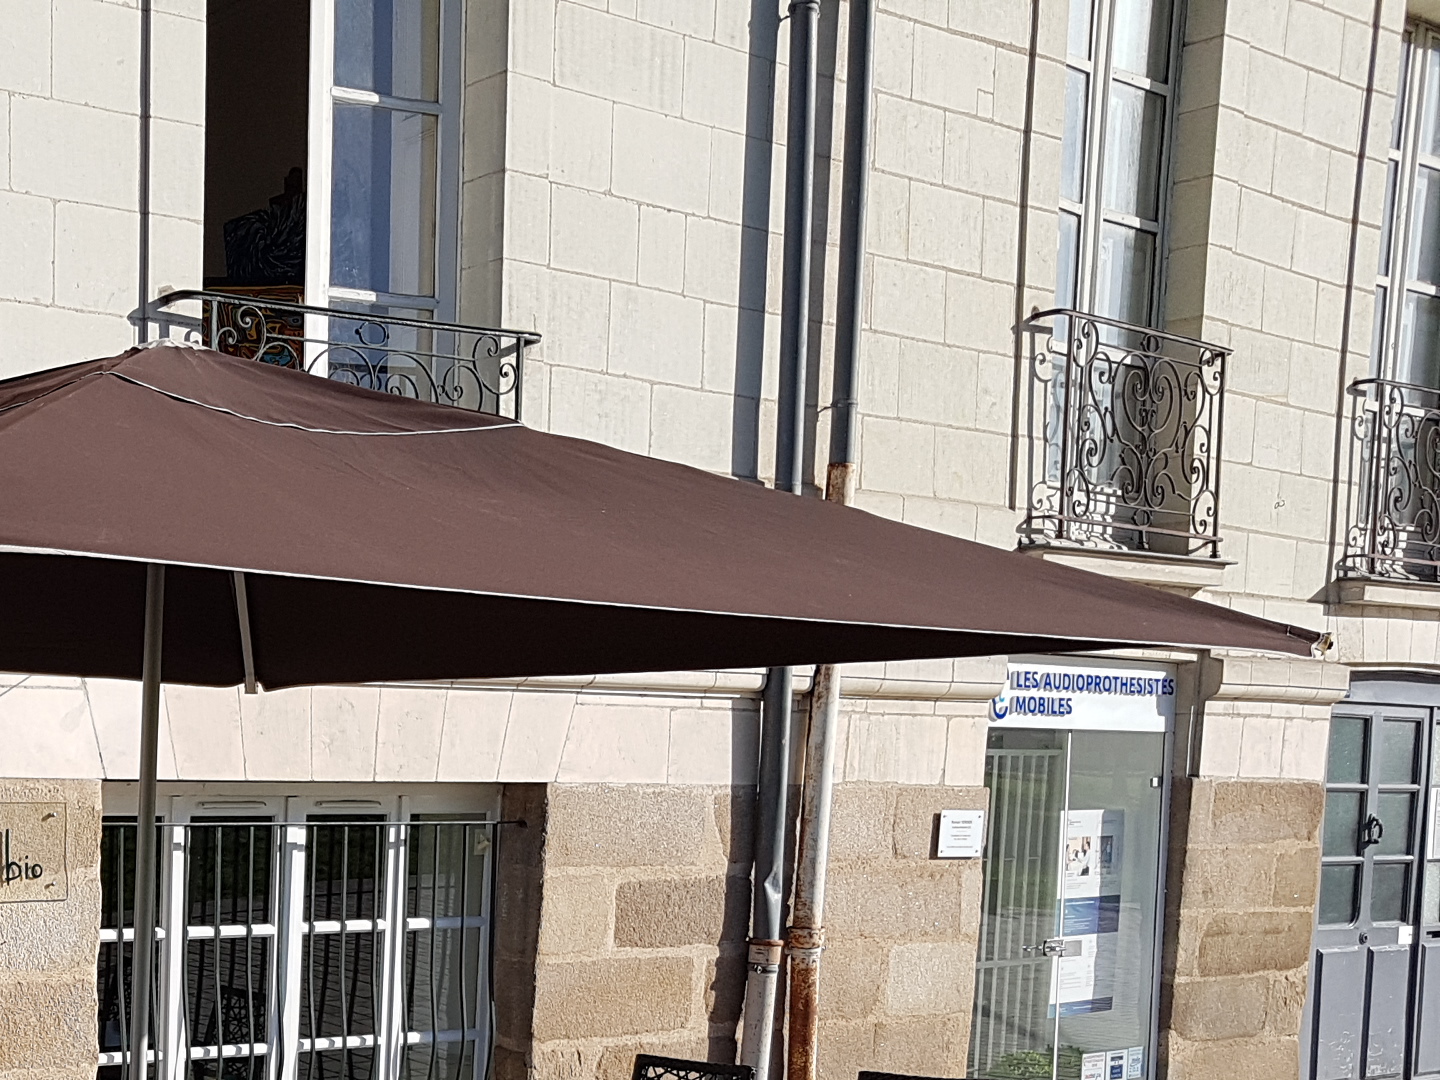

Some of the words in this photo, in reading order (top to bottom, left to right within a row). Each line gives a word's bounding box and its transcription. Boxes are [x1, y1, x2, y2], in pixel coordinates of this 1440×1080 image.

[1016, 670, 1039, 688] LES
[1043, 672, 1175, 696] AUDIOPROTHESISTES
[1015, 696, 1073, 715] MOBILES
